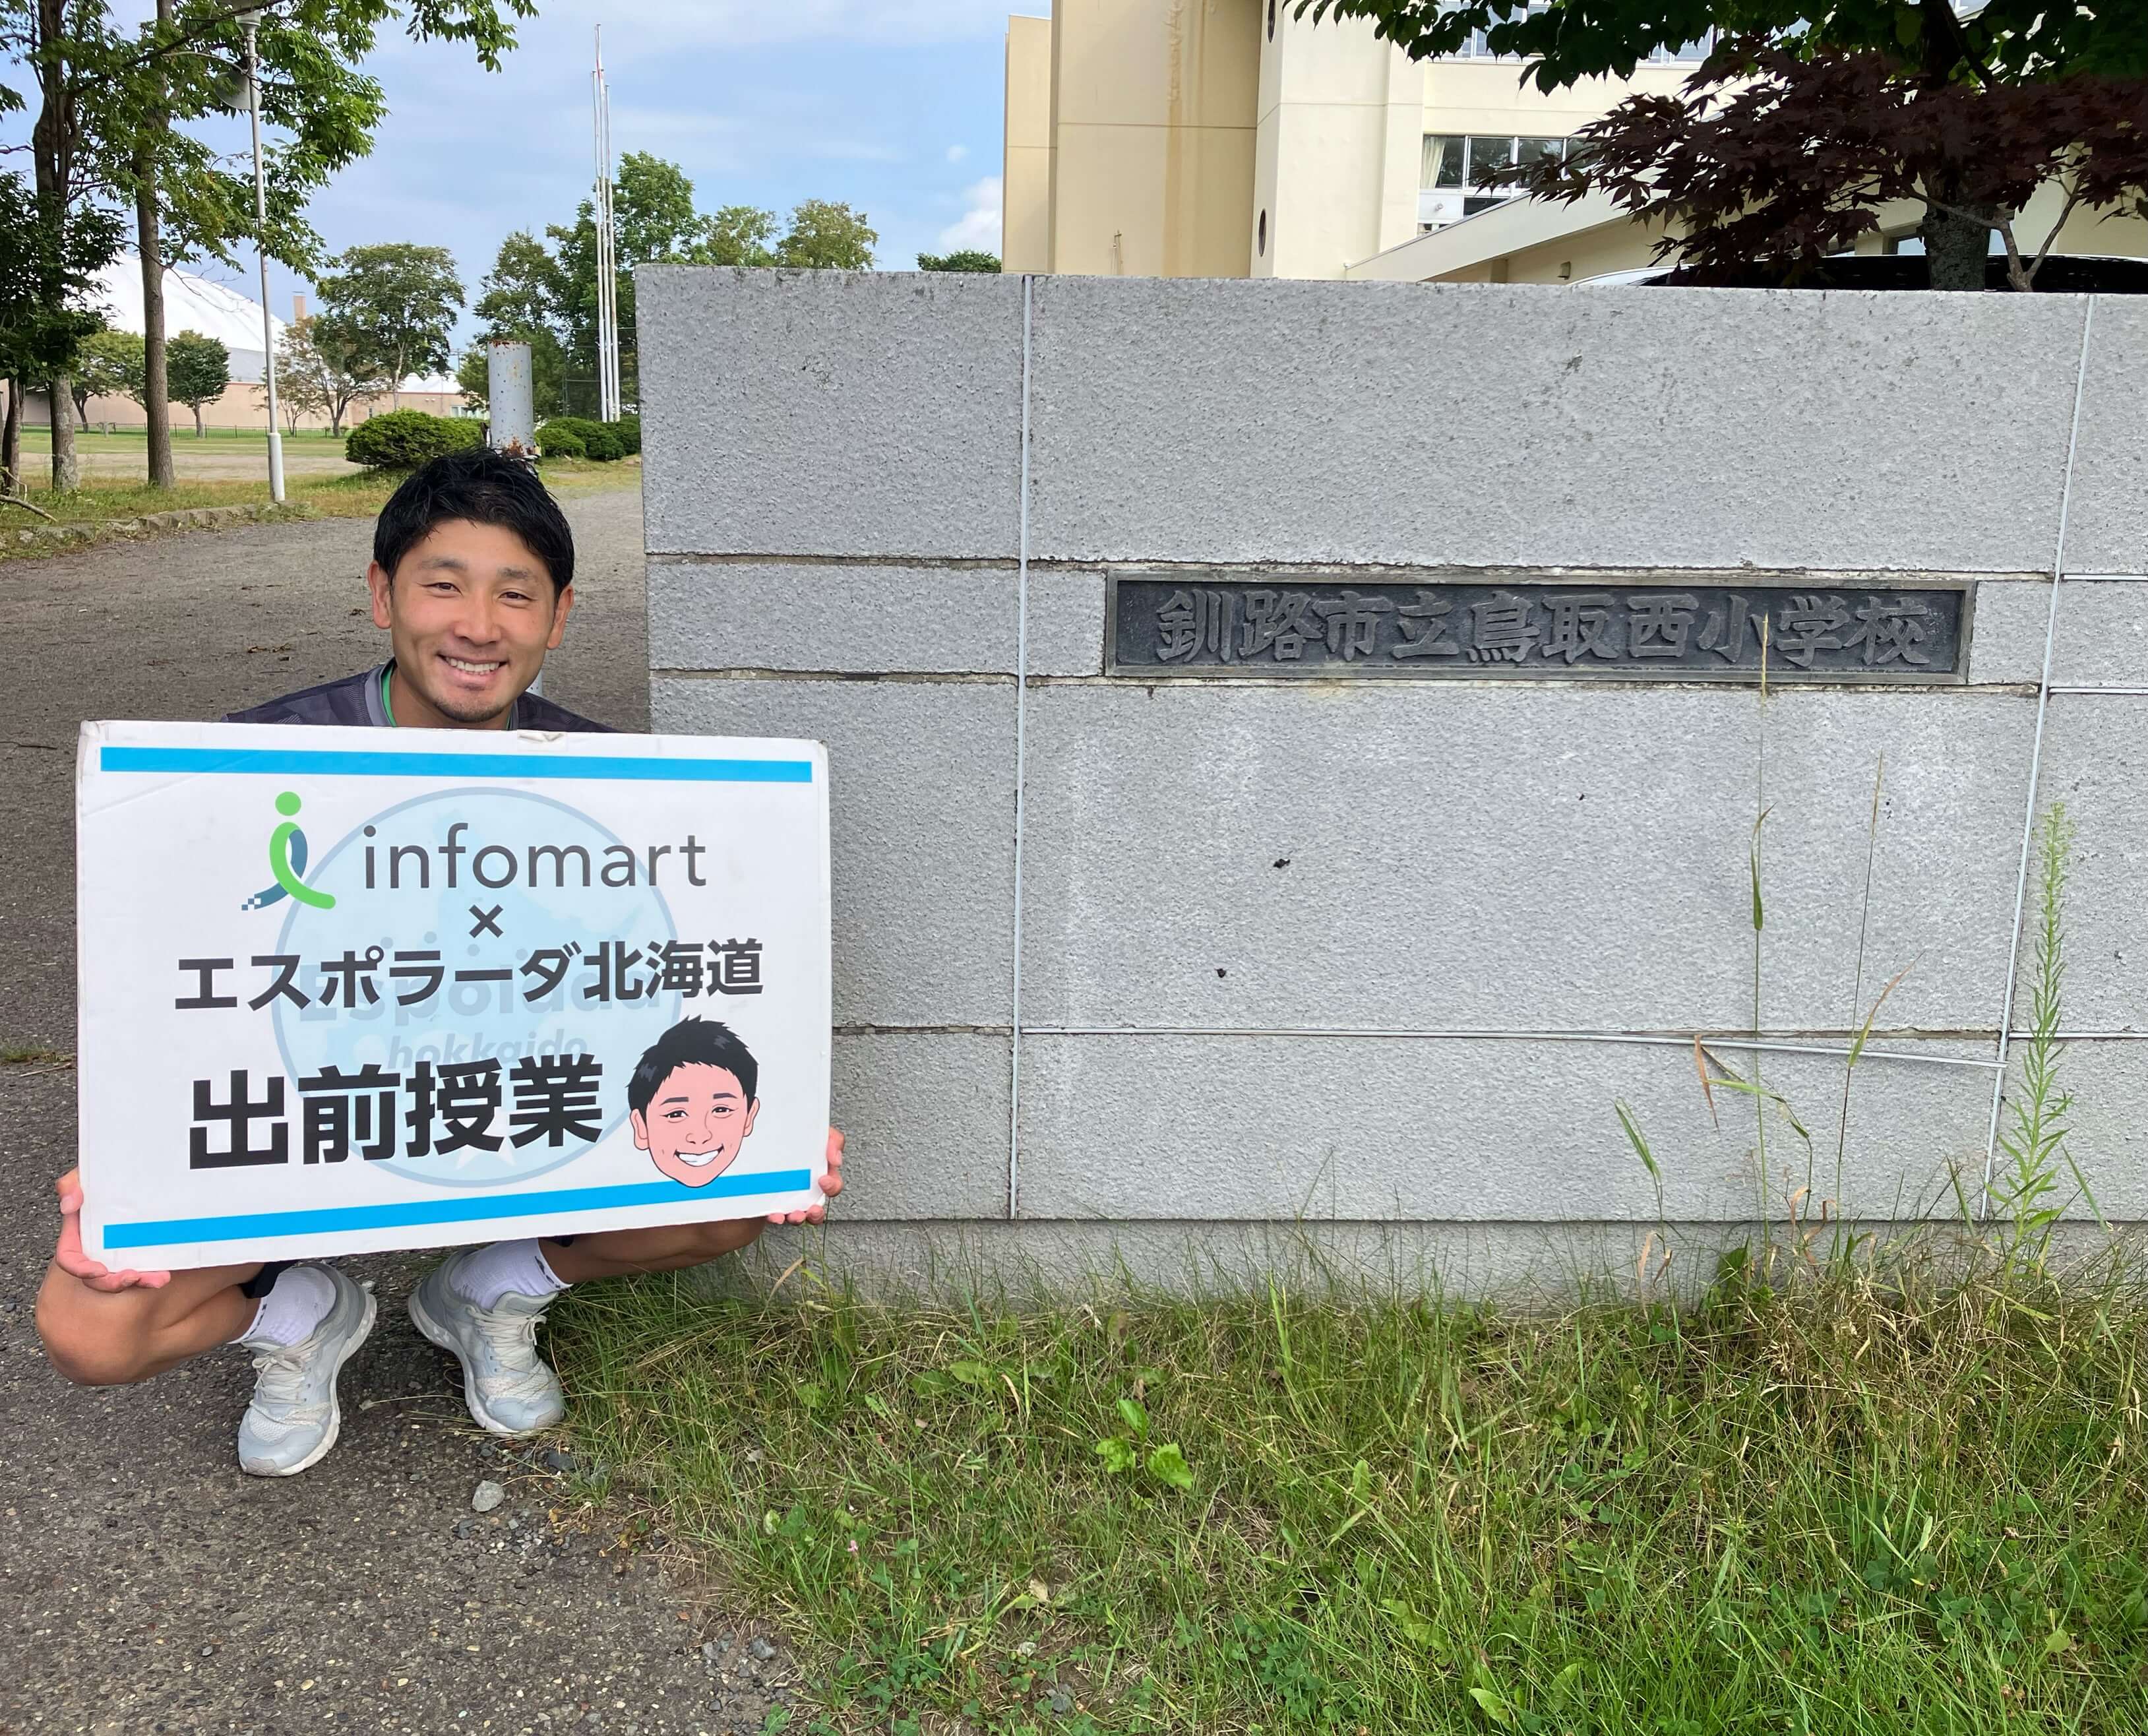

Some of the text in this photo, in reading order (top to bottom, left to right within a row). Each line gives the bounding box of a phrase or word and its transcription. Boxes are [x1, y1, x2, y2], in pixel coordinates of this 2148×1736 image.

[1155, 589, 1930, 667] 釧路市立鳥取西小学校
[364, 823, 706, 889] infomart
[175, 937, 764, 1011] エスポラーダ北海道
[387, 1029, 588, 1069] hokkaido
[189, 1053, 603, 1170] 出前授業
